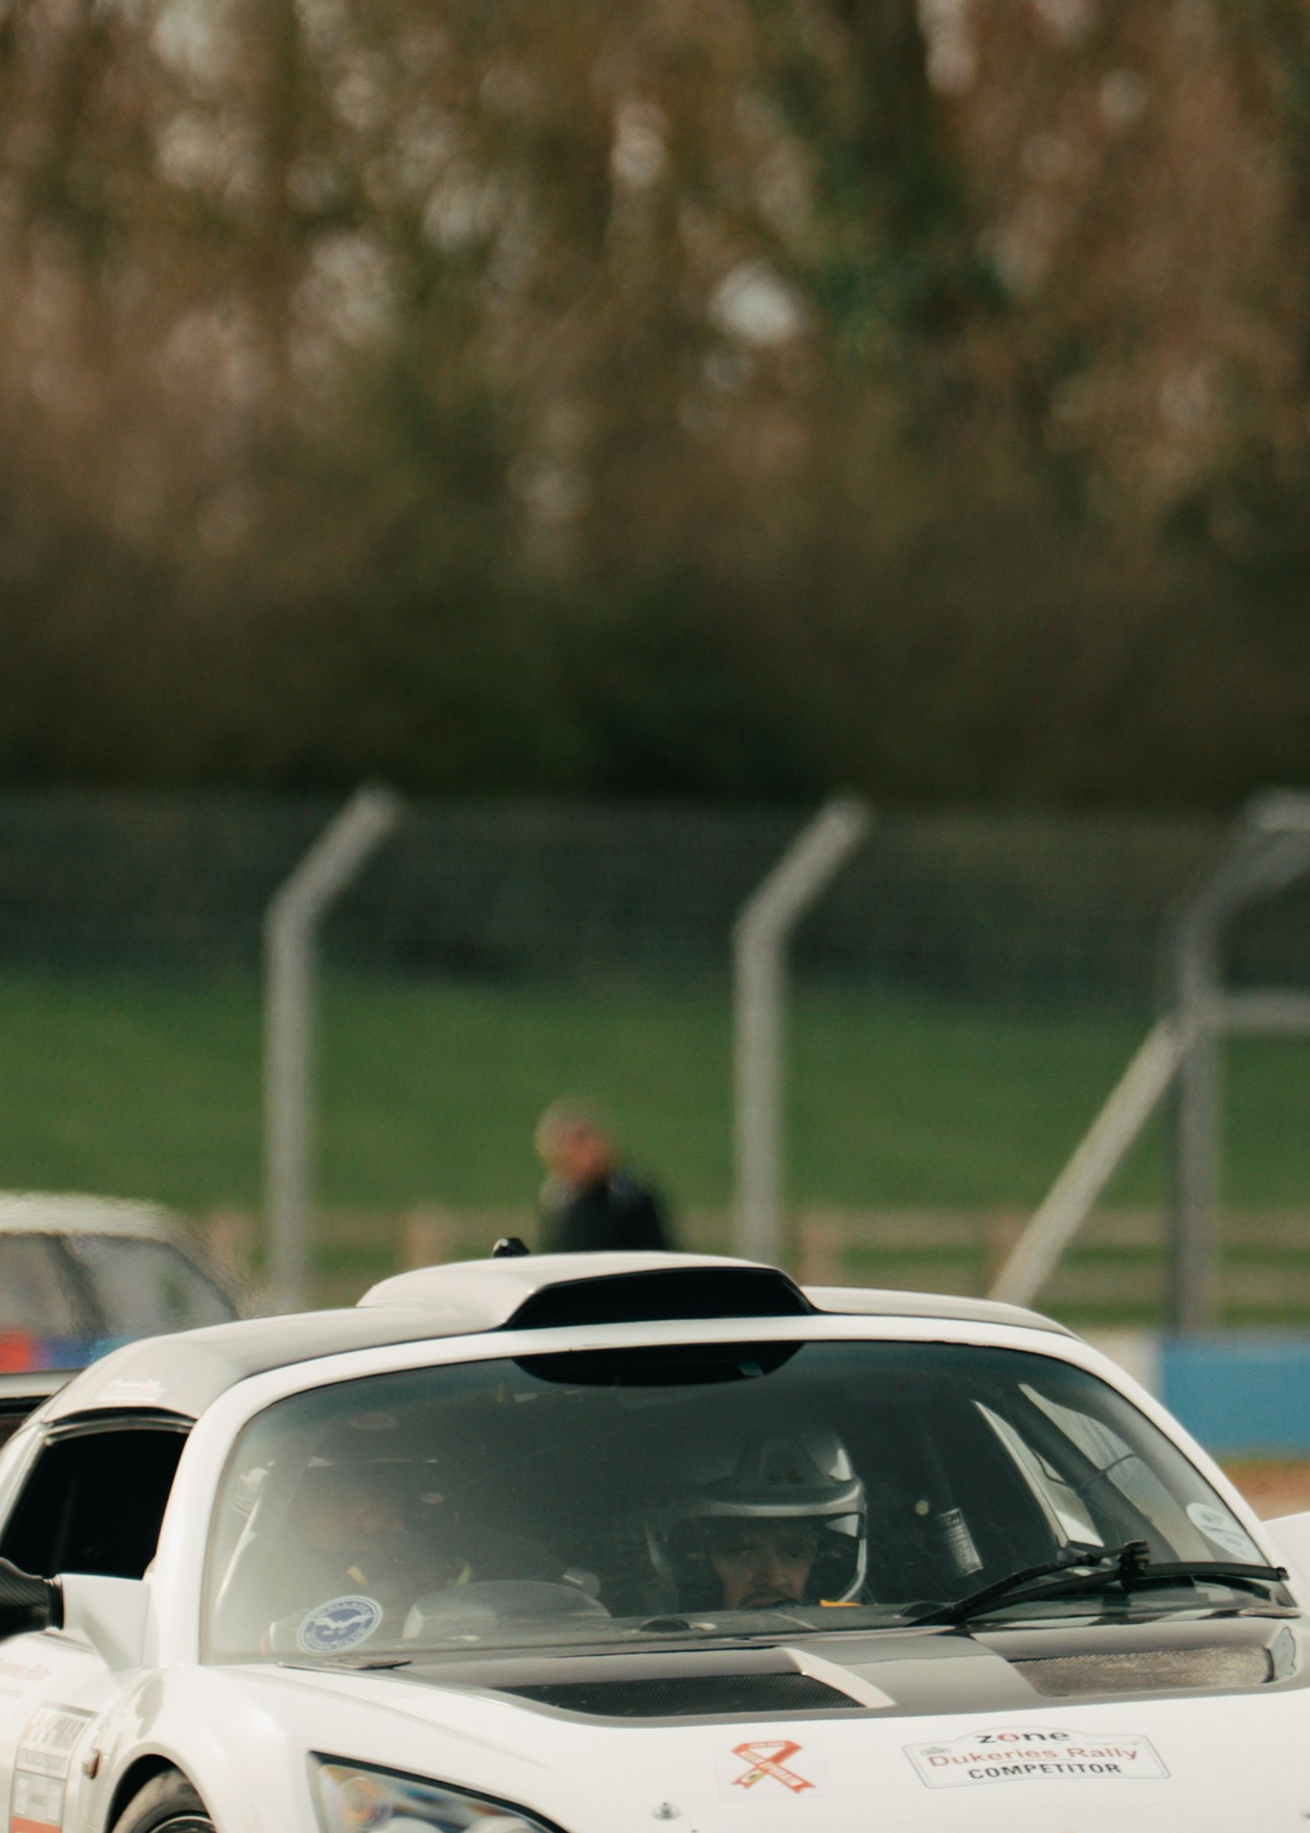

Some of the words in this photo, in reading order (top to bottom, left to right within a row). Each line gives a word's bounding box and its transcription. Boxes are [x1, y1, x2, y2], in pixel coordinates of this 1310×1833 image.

[975, 1731, 1071, 1744] zone
[927, 1747, 1059, 1767] Dukeries
[1066, 1746, 1139, 1761] Rally
[967, 1762, 1123, 1780] COMPETITOR
